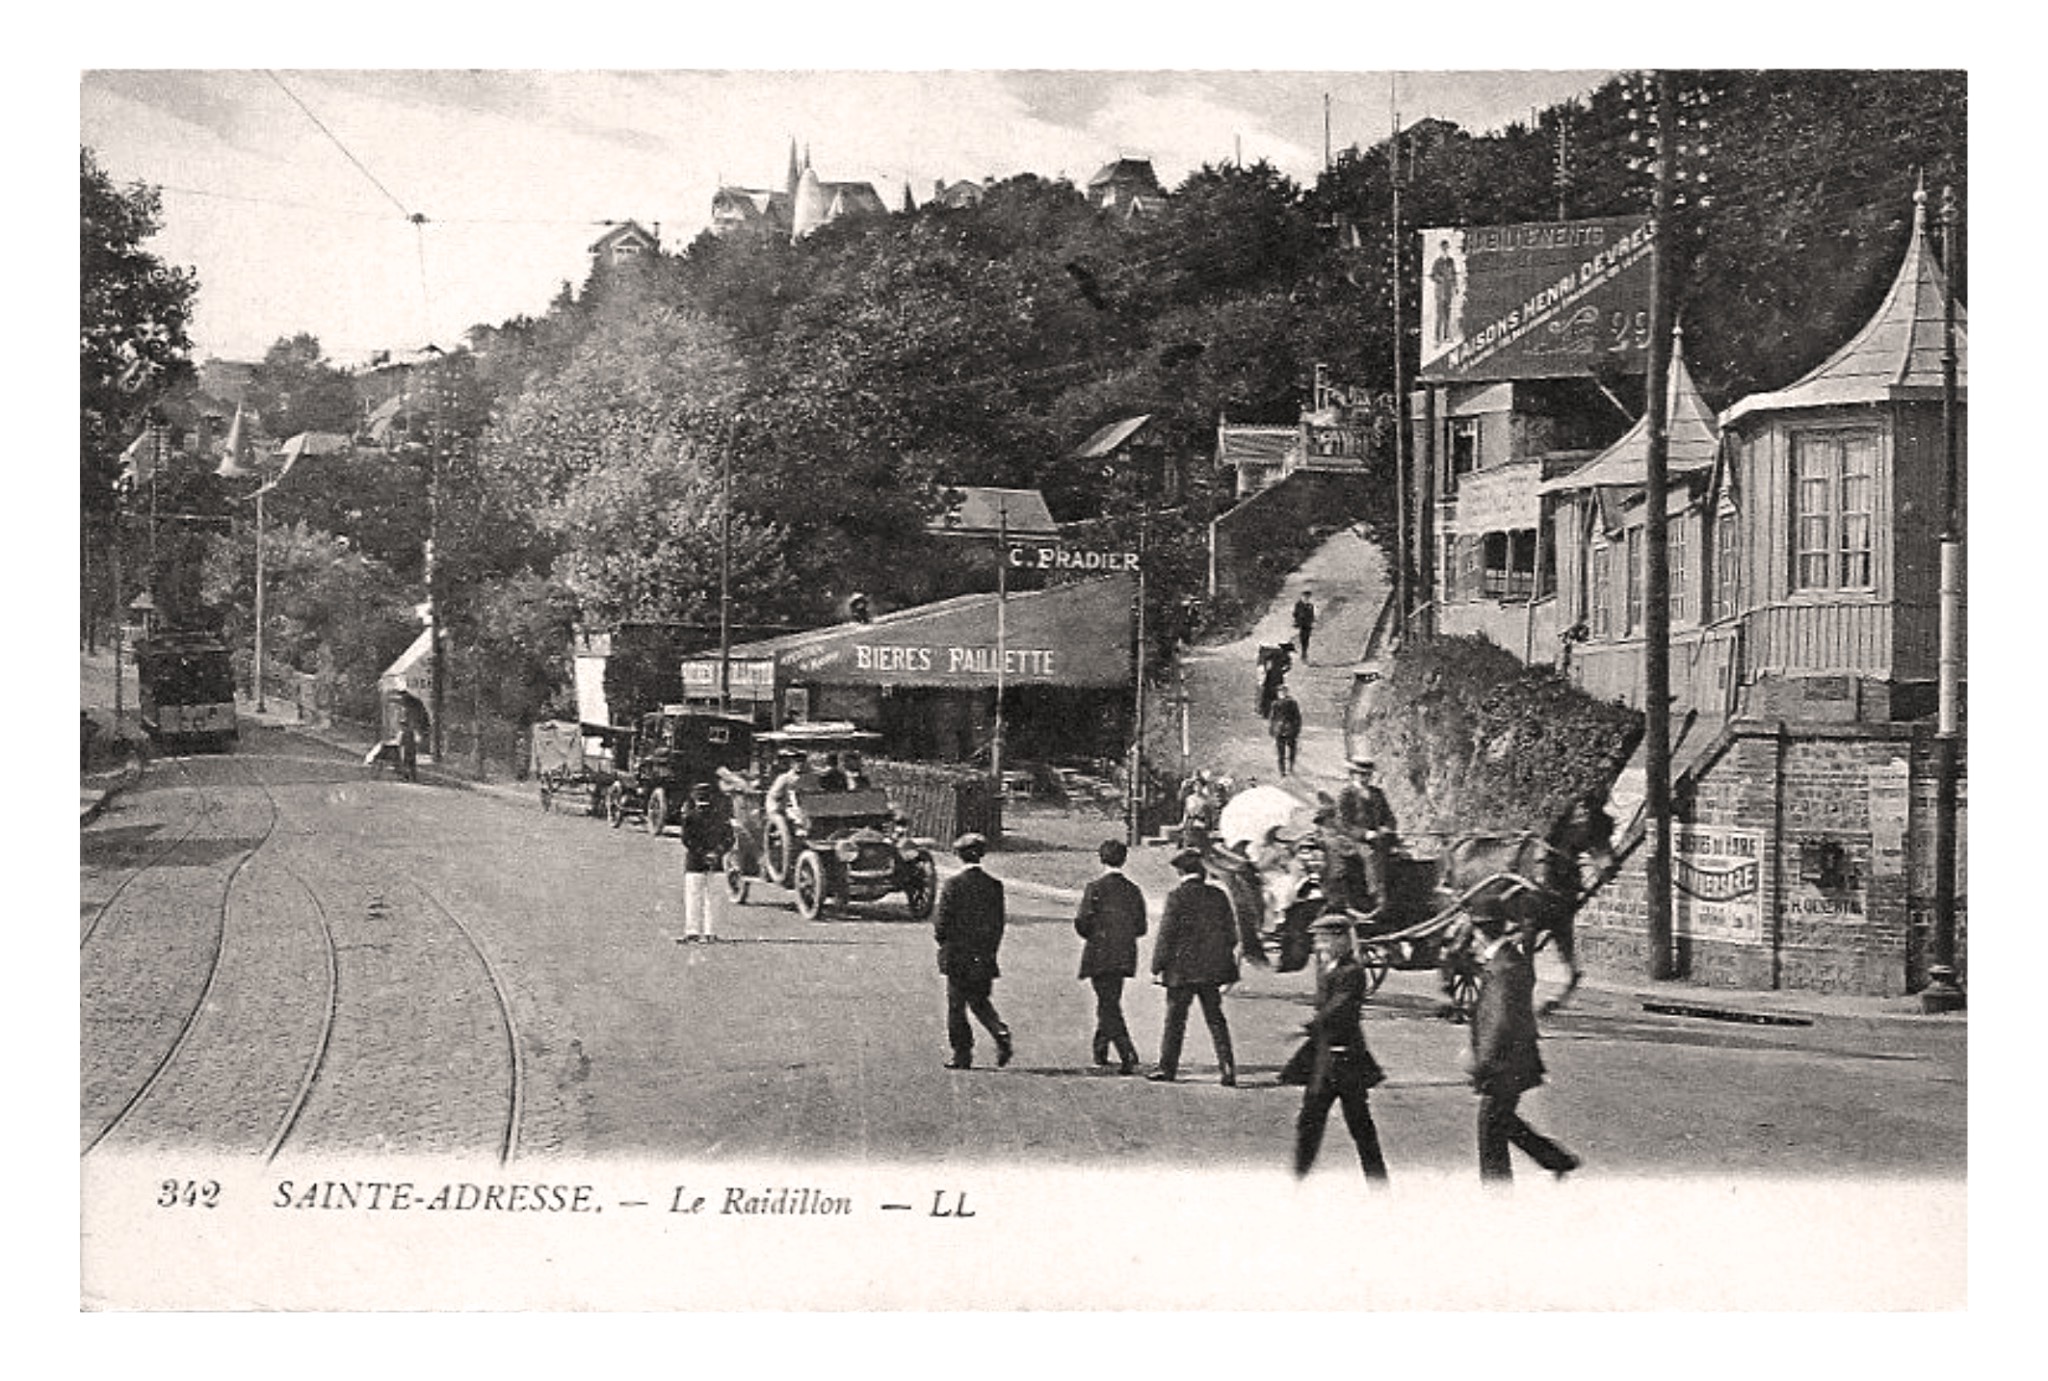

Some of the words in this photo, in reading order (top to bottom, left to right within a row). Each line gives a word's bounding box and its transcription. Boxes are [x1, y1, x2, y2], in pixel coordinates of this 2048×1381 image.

[1448, 310, 1521, 369] MAISONS
[1523, 273, 1576, 319] HENRI
[1036, 549, 1140, 571] PRADIER
[856, 645, 931, 671] BIERES
[948, 648, 1054, 674] PAILLETTE
